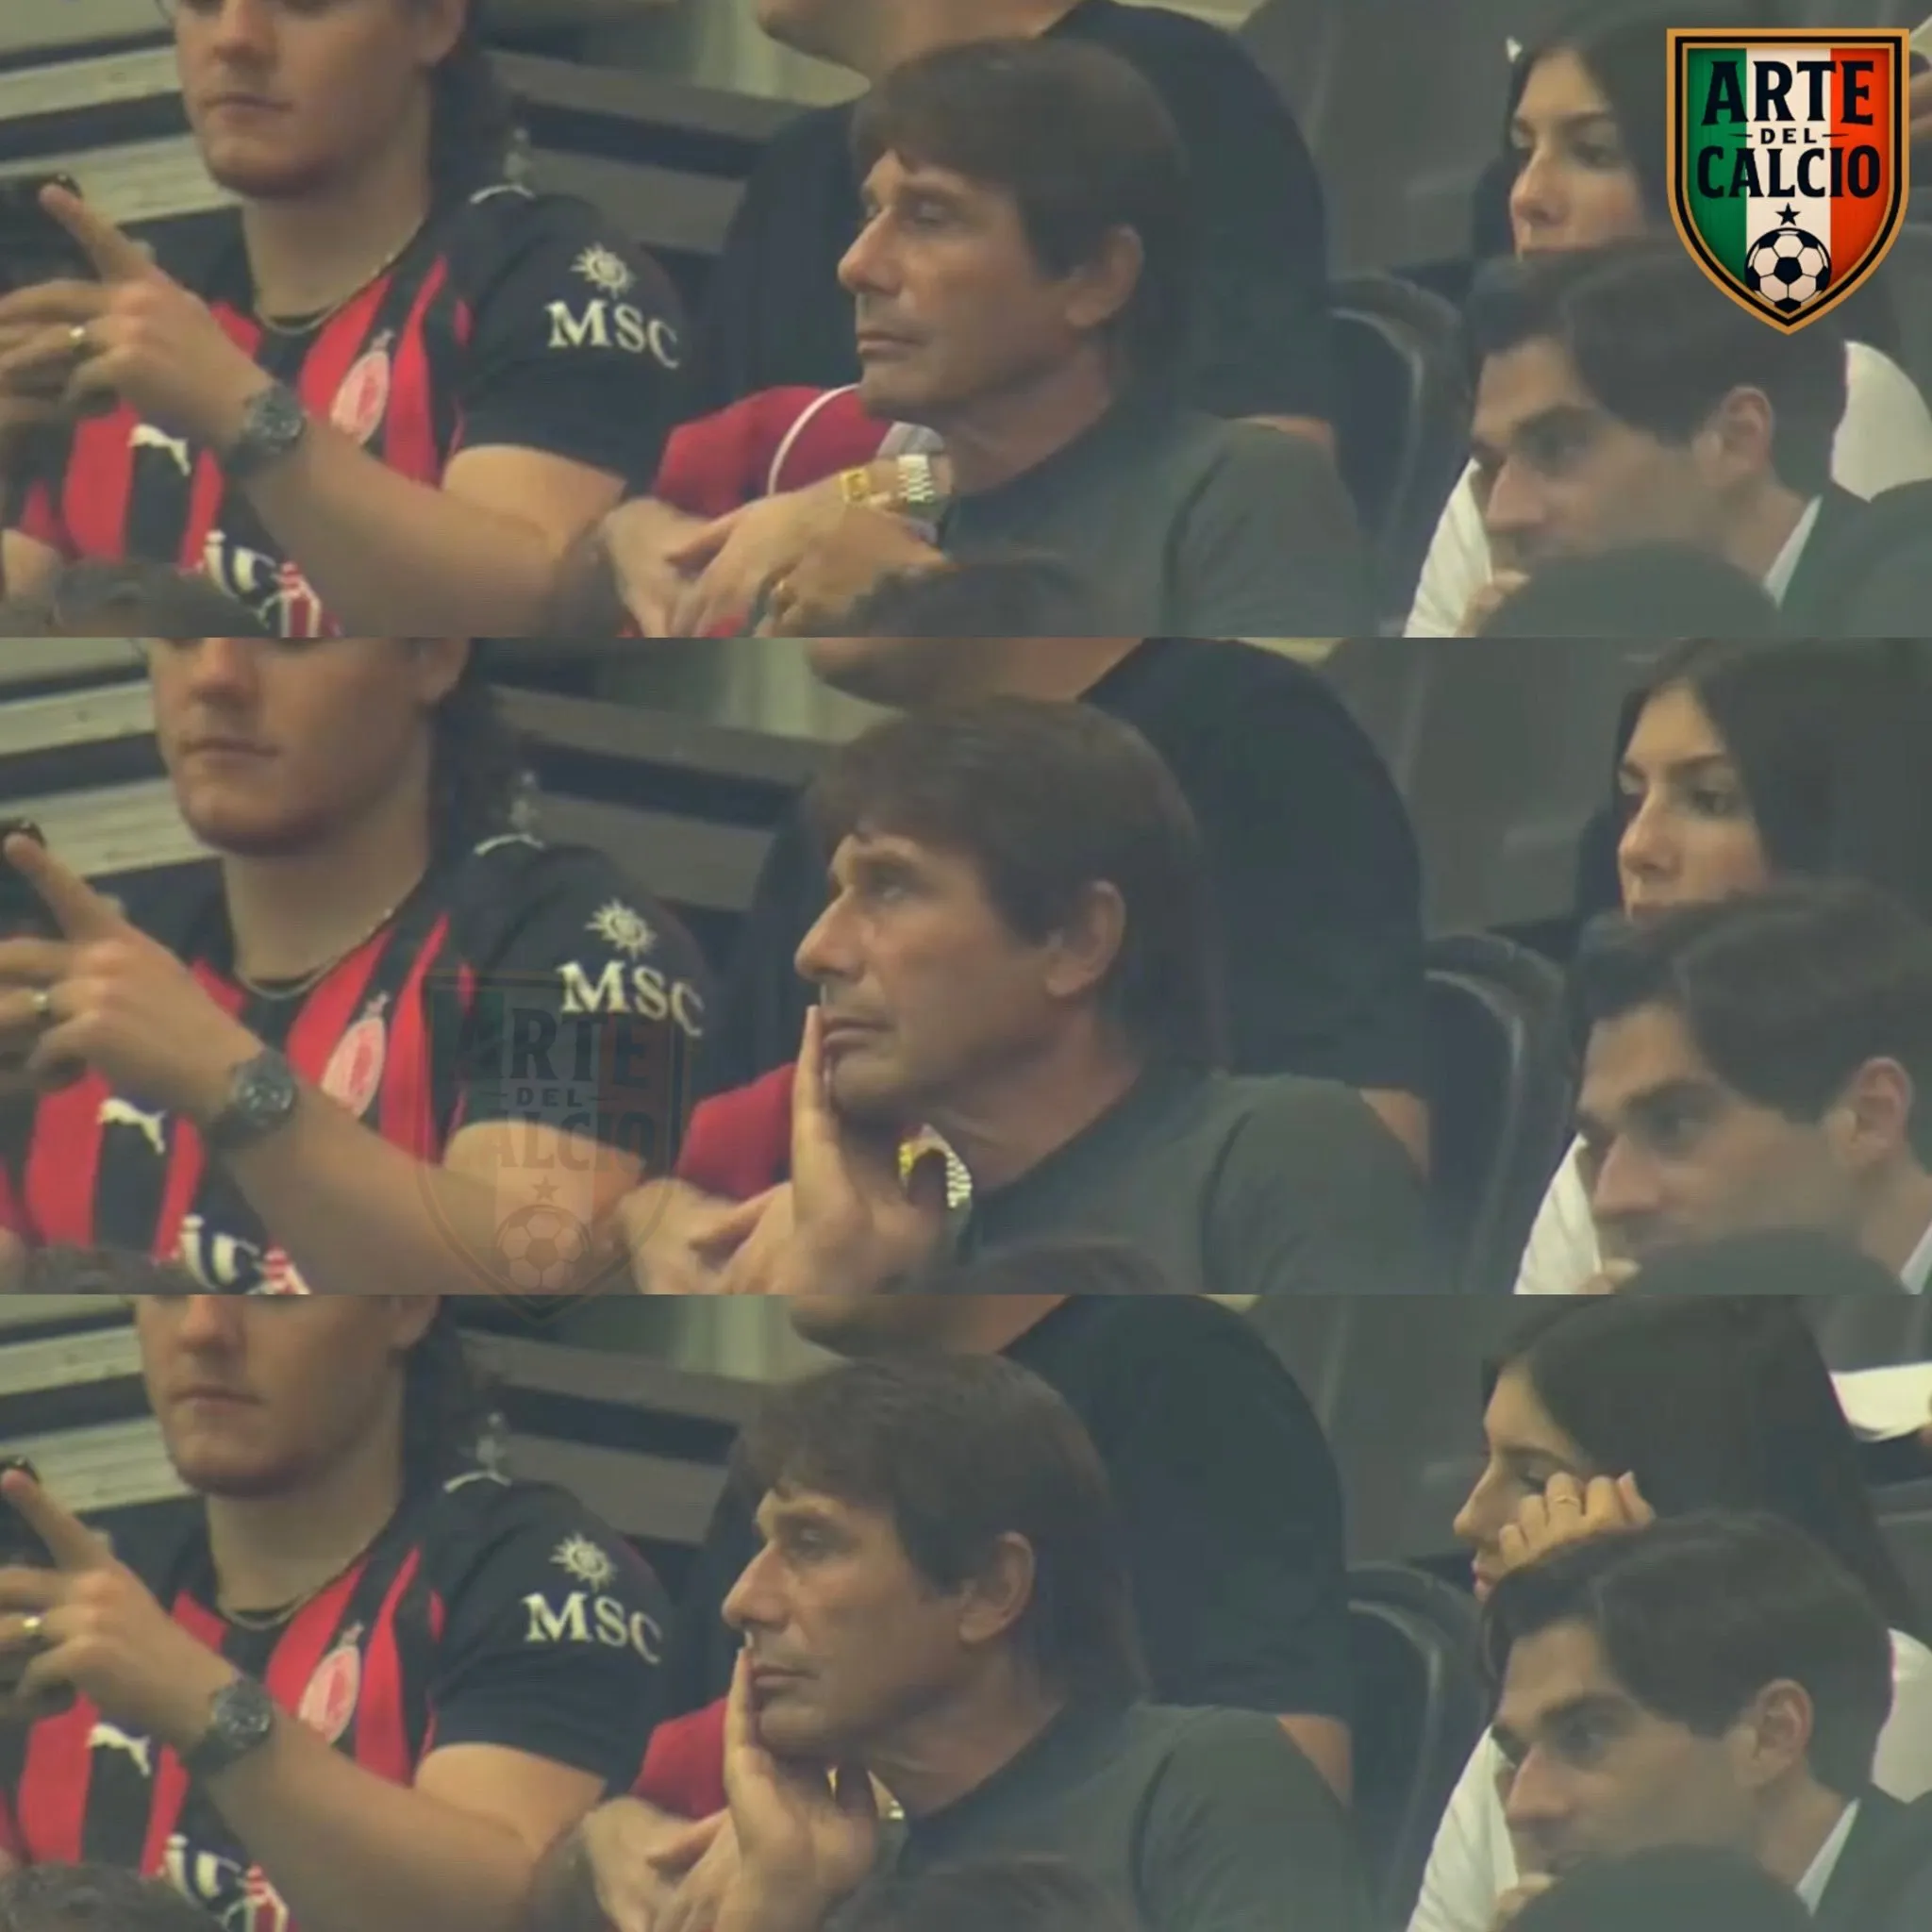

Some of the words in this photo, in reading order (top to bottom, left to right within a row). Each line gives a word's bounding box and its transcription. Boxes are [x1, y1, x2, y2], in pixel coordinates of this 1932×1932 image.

[544, 298, 680, 370] MSC
[555, 958, 706, 1037] MSC
[521, 1590, 662, 1665] MSC
